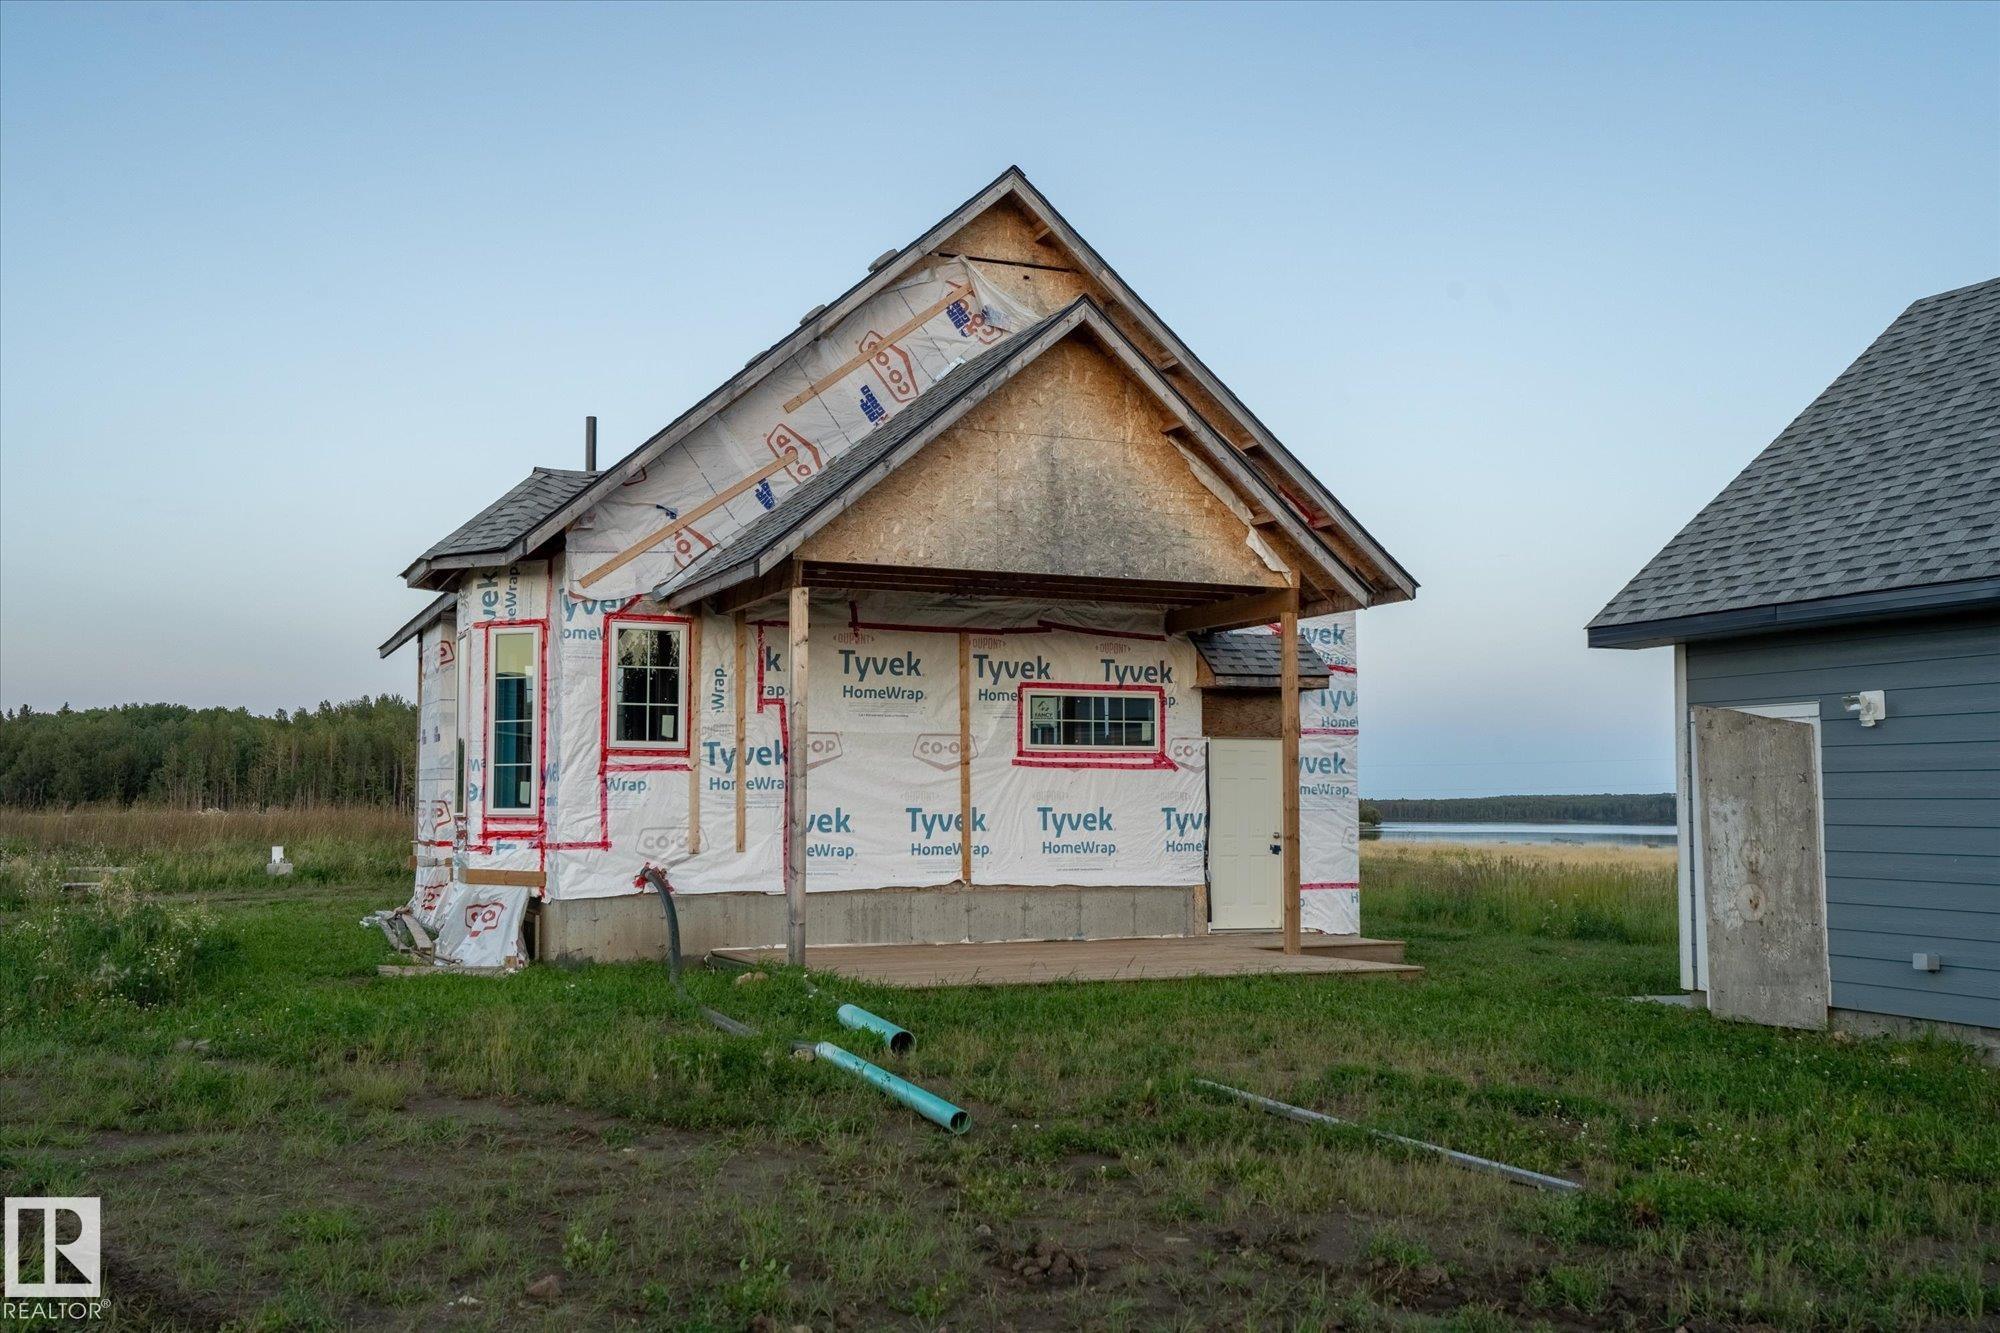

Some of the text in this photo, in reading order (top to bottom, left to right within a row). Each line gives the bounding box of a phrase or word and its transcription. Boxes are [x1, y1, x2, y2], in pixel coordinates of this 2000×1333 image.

[838, 649, 922, 683] Tyvek
[972, 653, 1052, 686] Tyvek
[1100, 658, 1174, 689] Tyvek
[842, 685, 925, 703] HomeWrap
[1036, 806, 1114, 839] Tyvek
[1041, 841, 1117, 857] HomeWrap
